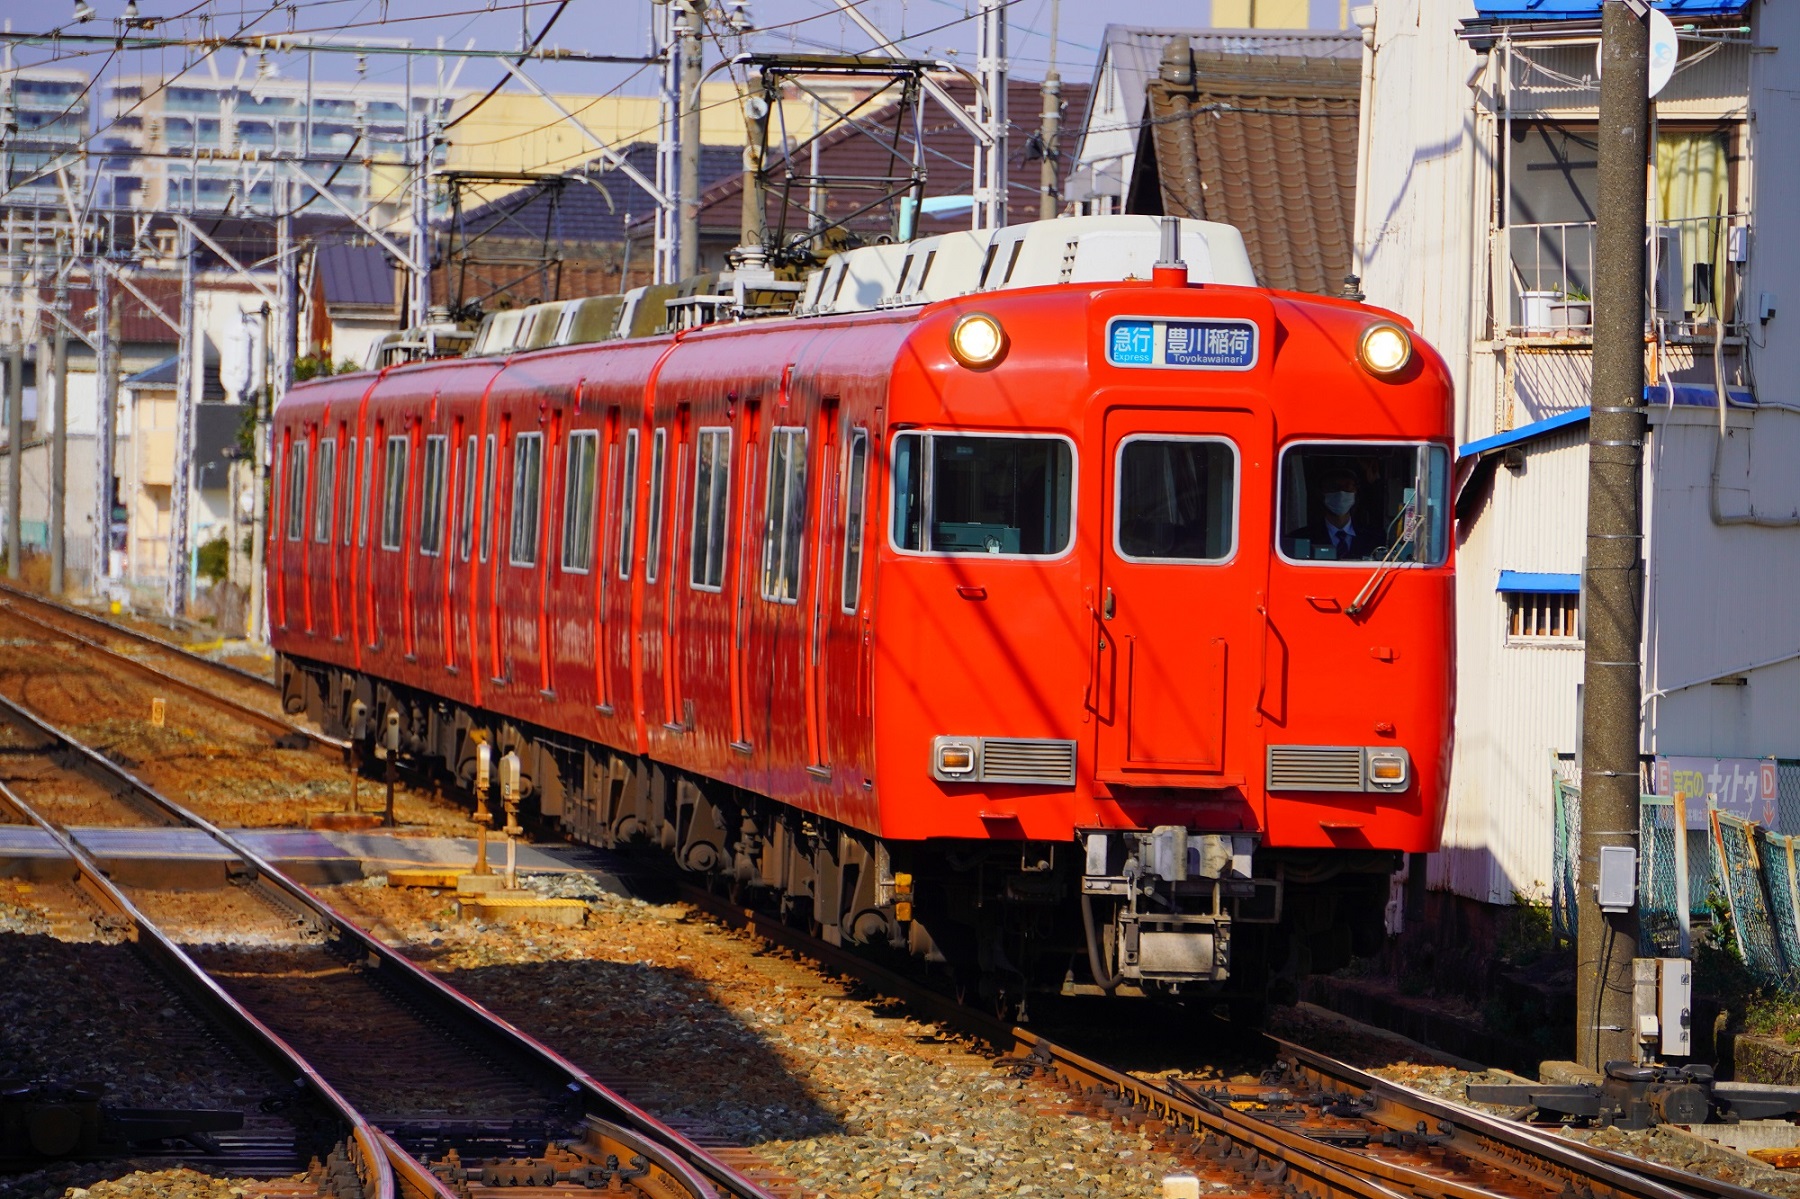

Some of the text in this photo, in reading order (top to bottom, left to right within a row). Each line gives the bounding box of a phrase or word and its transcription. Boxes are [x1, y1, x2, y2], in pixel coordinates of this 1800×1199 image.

[1114, 327, 1150, 353] 急行
[1167, 327, 1250, 355] 豊川稲荷
[1114, 352, 1150, 362] Express
[1173, 353, 1243, 364] Toyokawainari
[1660, 766, 1668, 791] E
[1763, 770, 1773, 794] D
